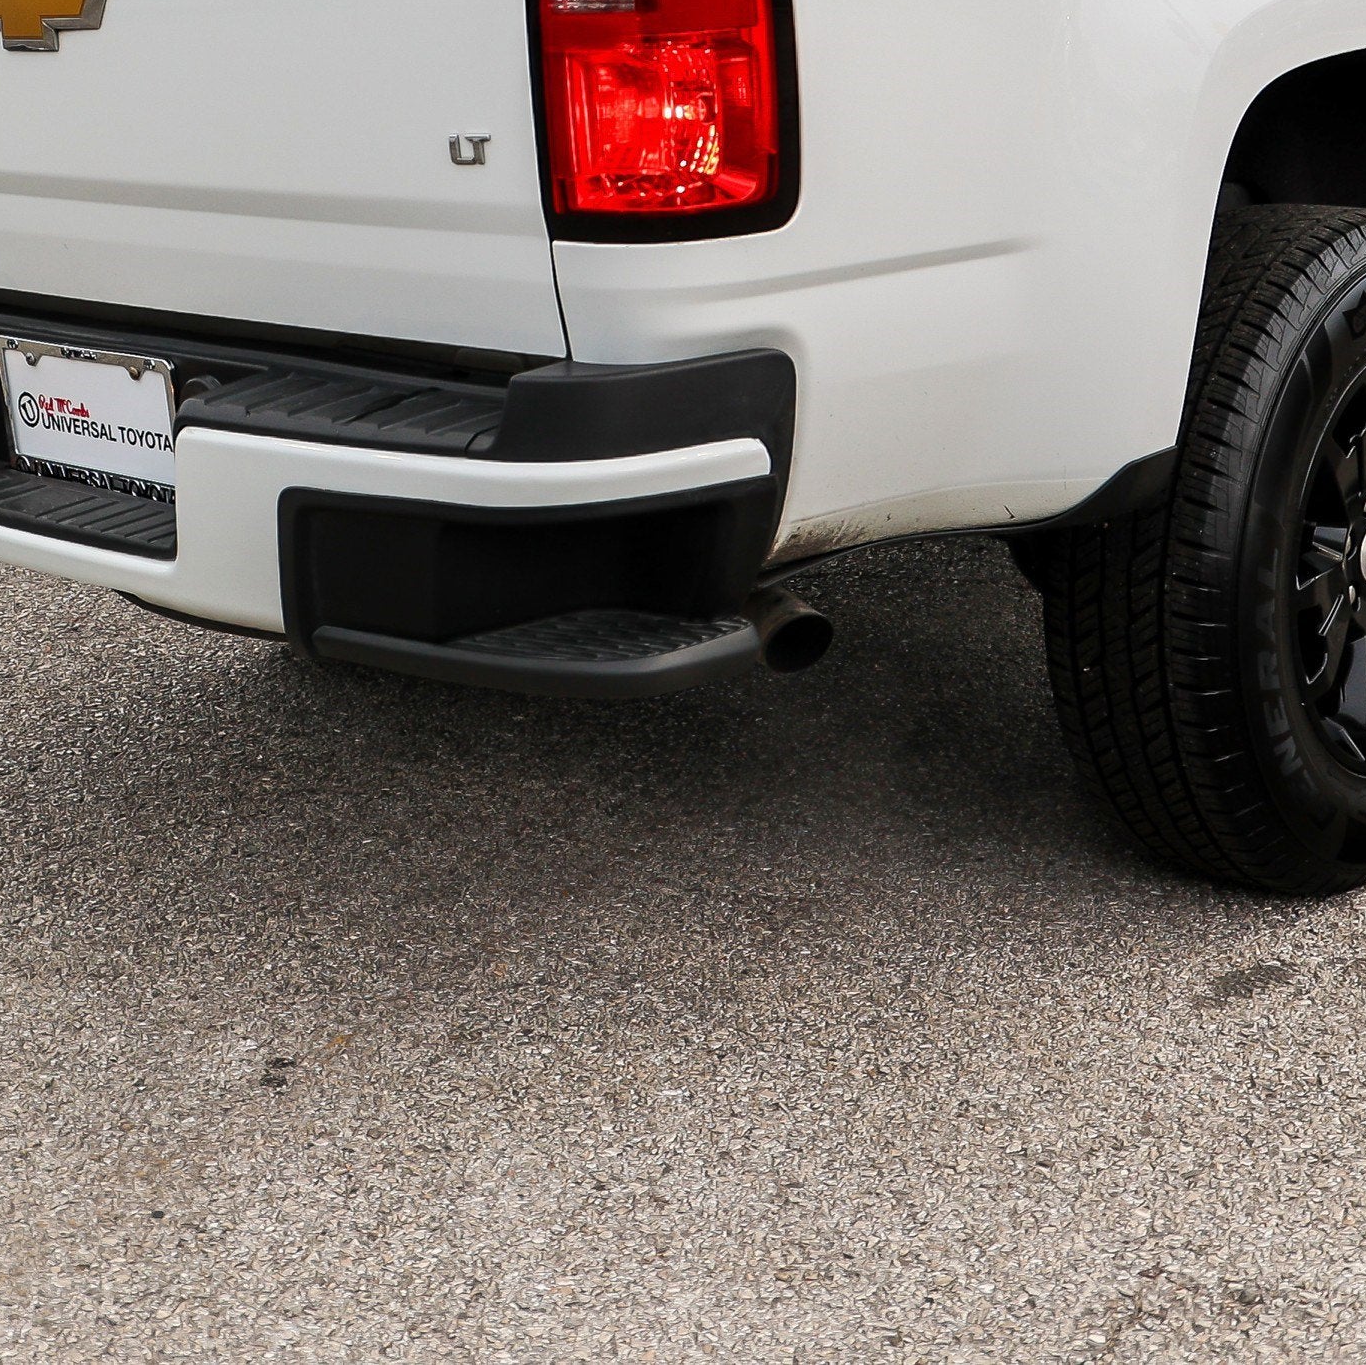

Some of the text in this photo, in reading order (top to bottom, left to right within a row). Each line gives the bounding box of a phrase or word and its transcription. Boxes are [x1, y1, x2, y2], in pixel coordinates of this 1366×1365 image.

[449, 133, 491, 165] LT
[41, 412, 174, 452] UNIVERSAL TOYOTA
[35, 459, 120, 492] UNIVERSAL
